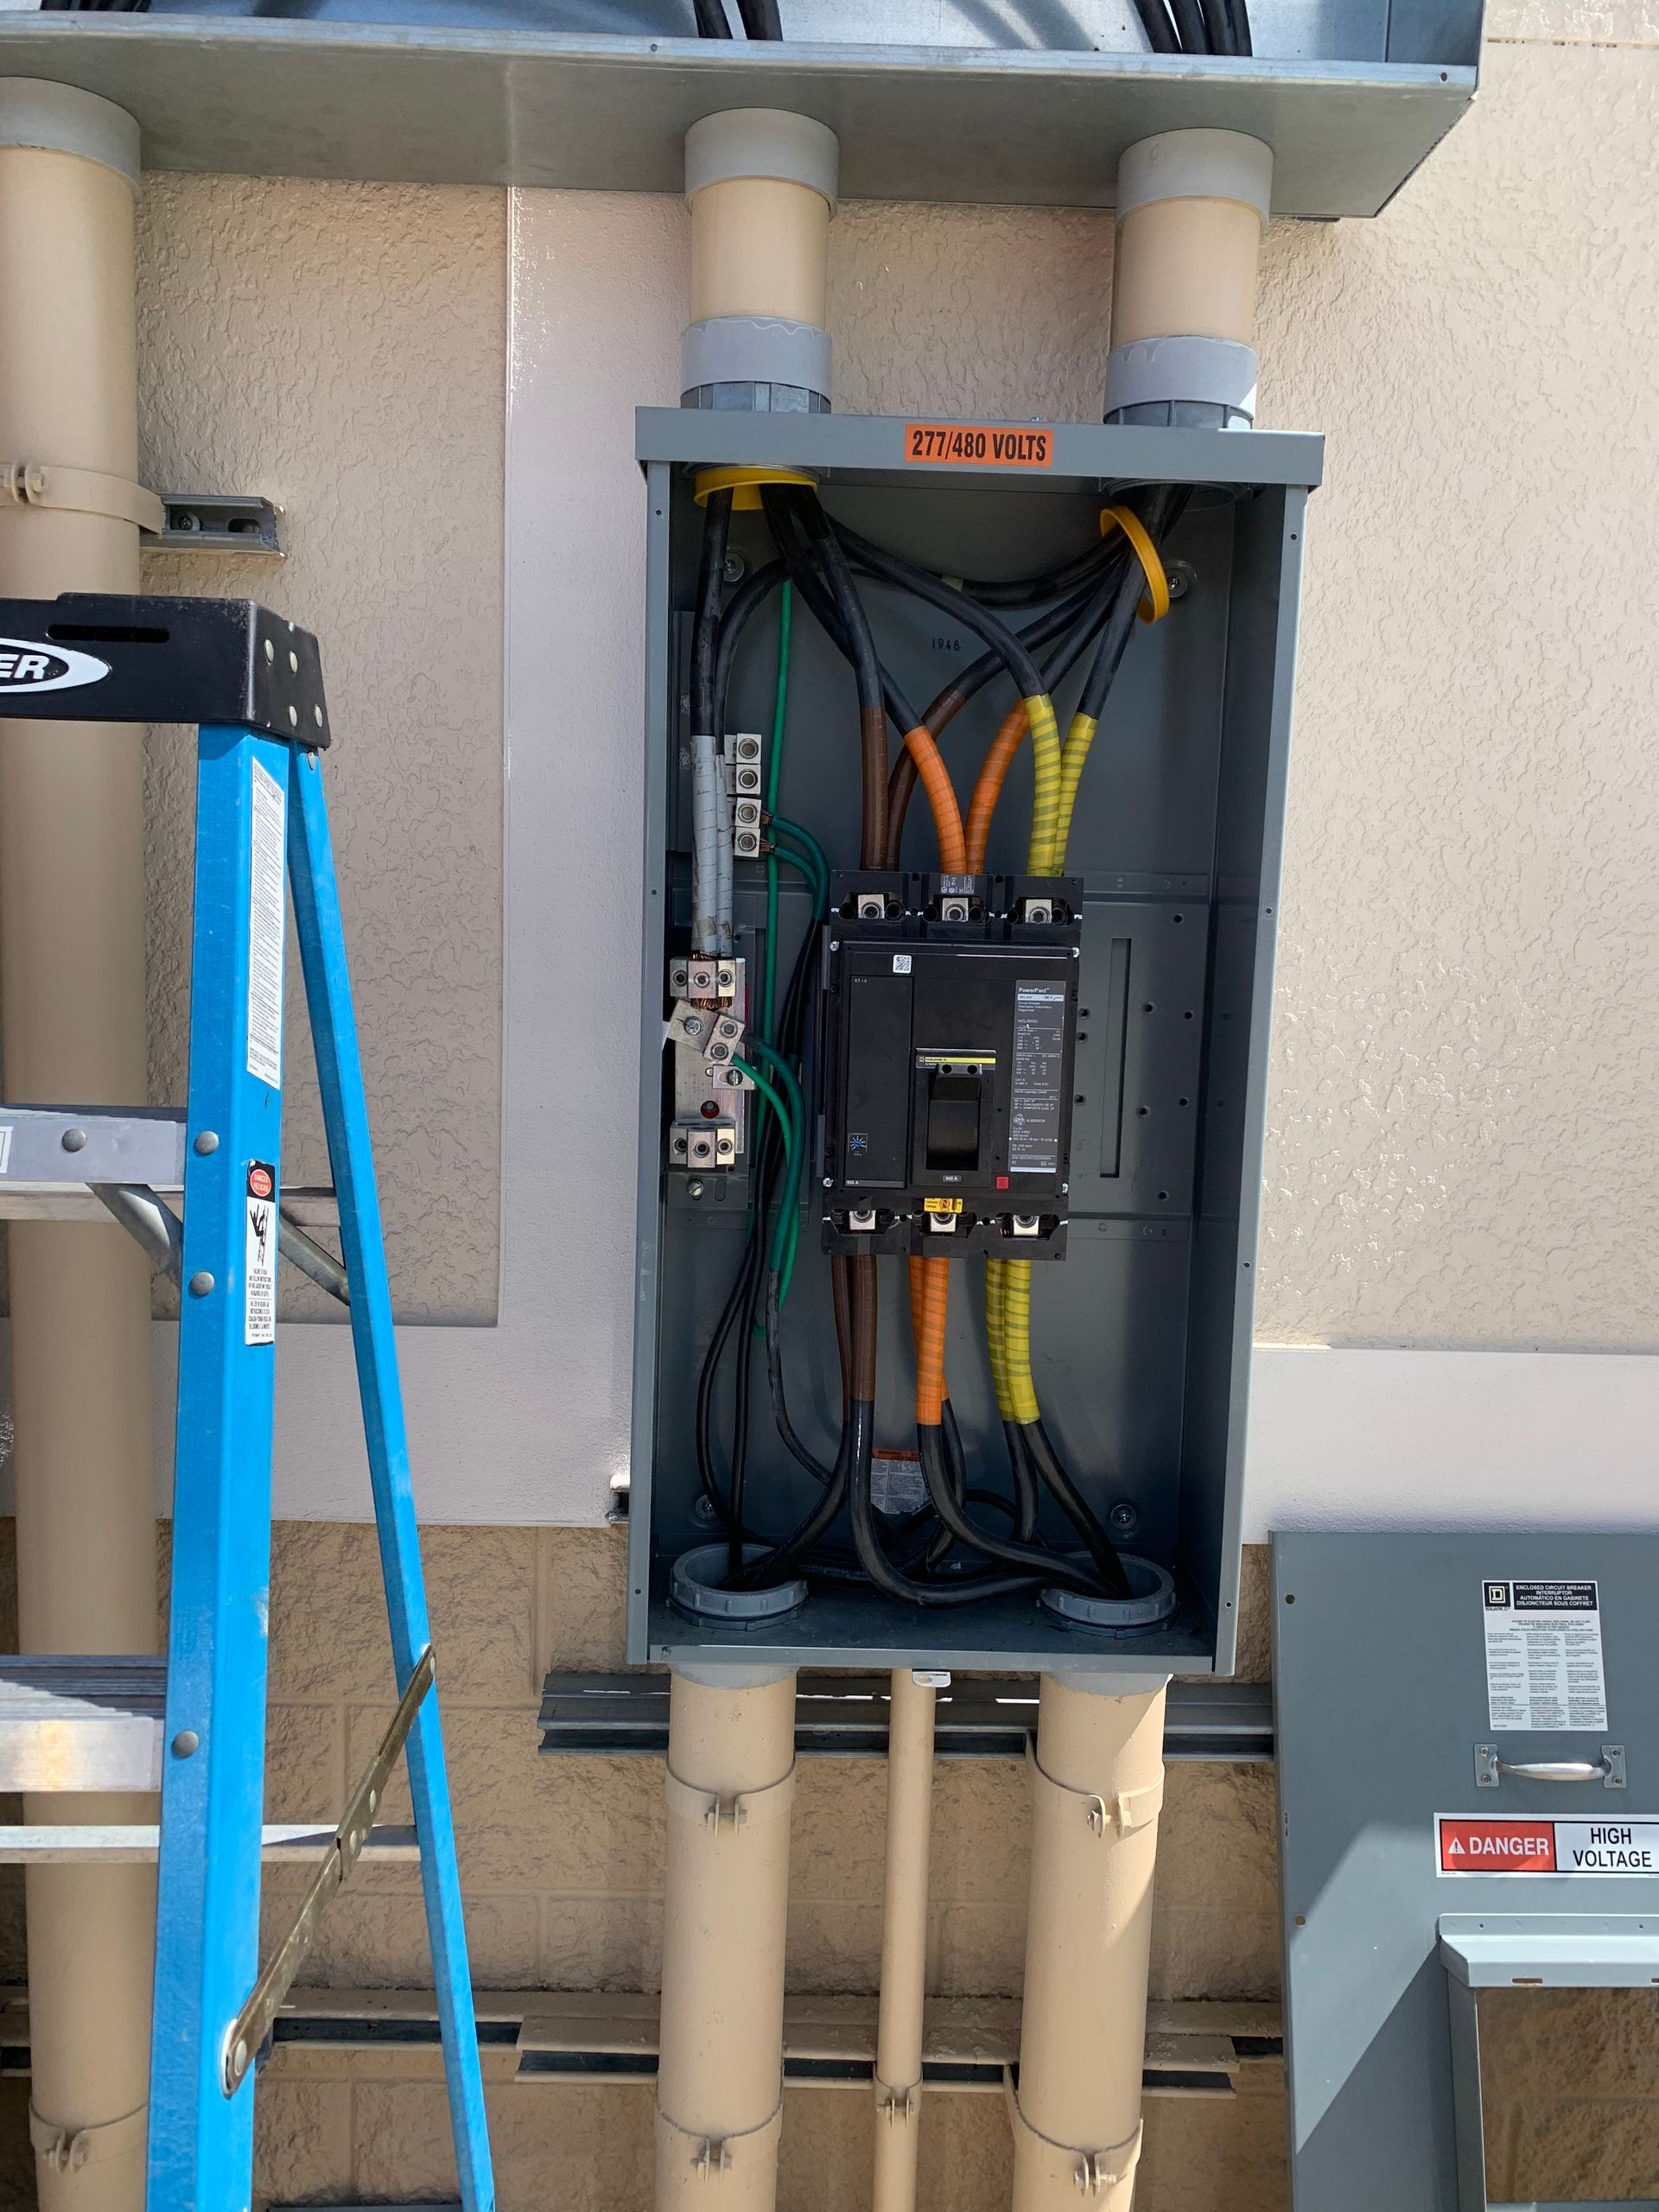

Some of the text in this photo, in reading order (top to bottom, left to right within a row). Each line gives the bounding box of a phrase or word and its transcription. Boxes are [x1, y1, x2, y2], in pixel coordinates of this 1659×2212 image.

[912, 430, 1046, 461] 277/480 VOLTS
[1590, 1827, 1632, 1845] HIGH
[1469, 1836, 1549, 1856] DANGER
[1573, 1850, 1652, 1868] VOLTAGE
